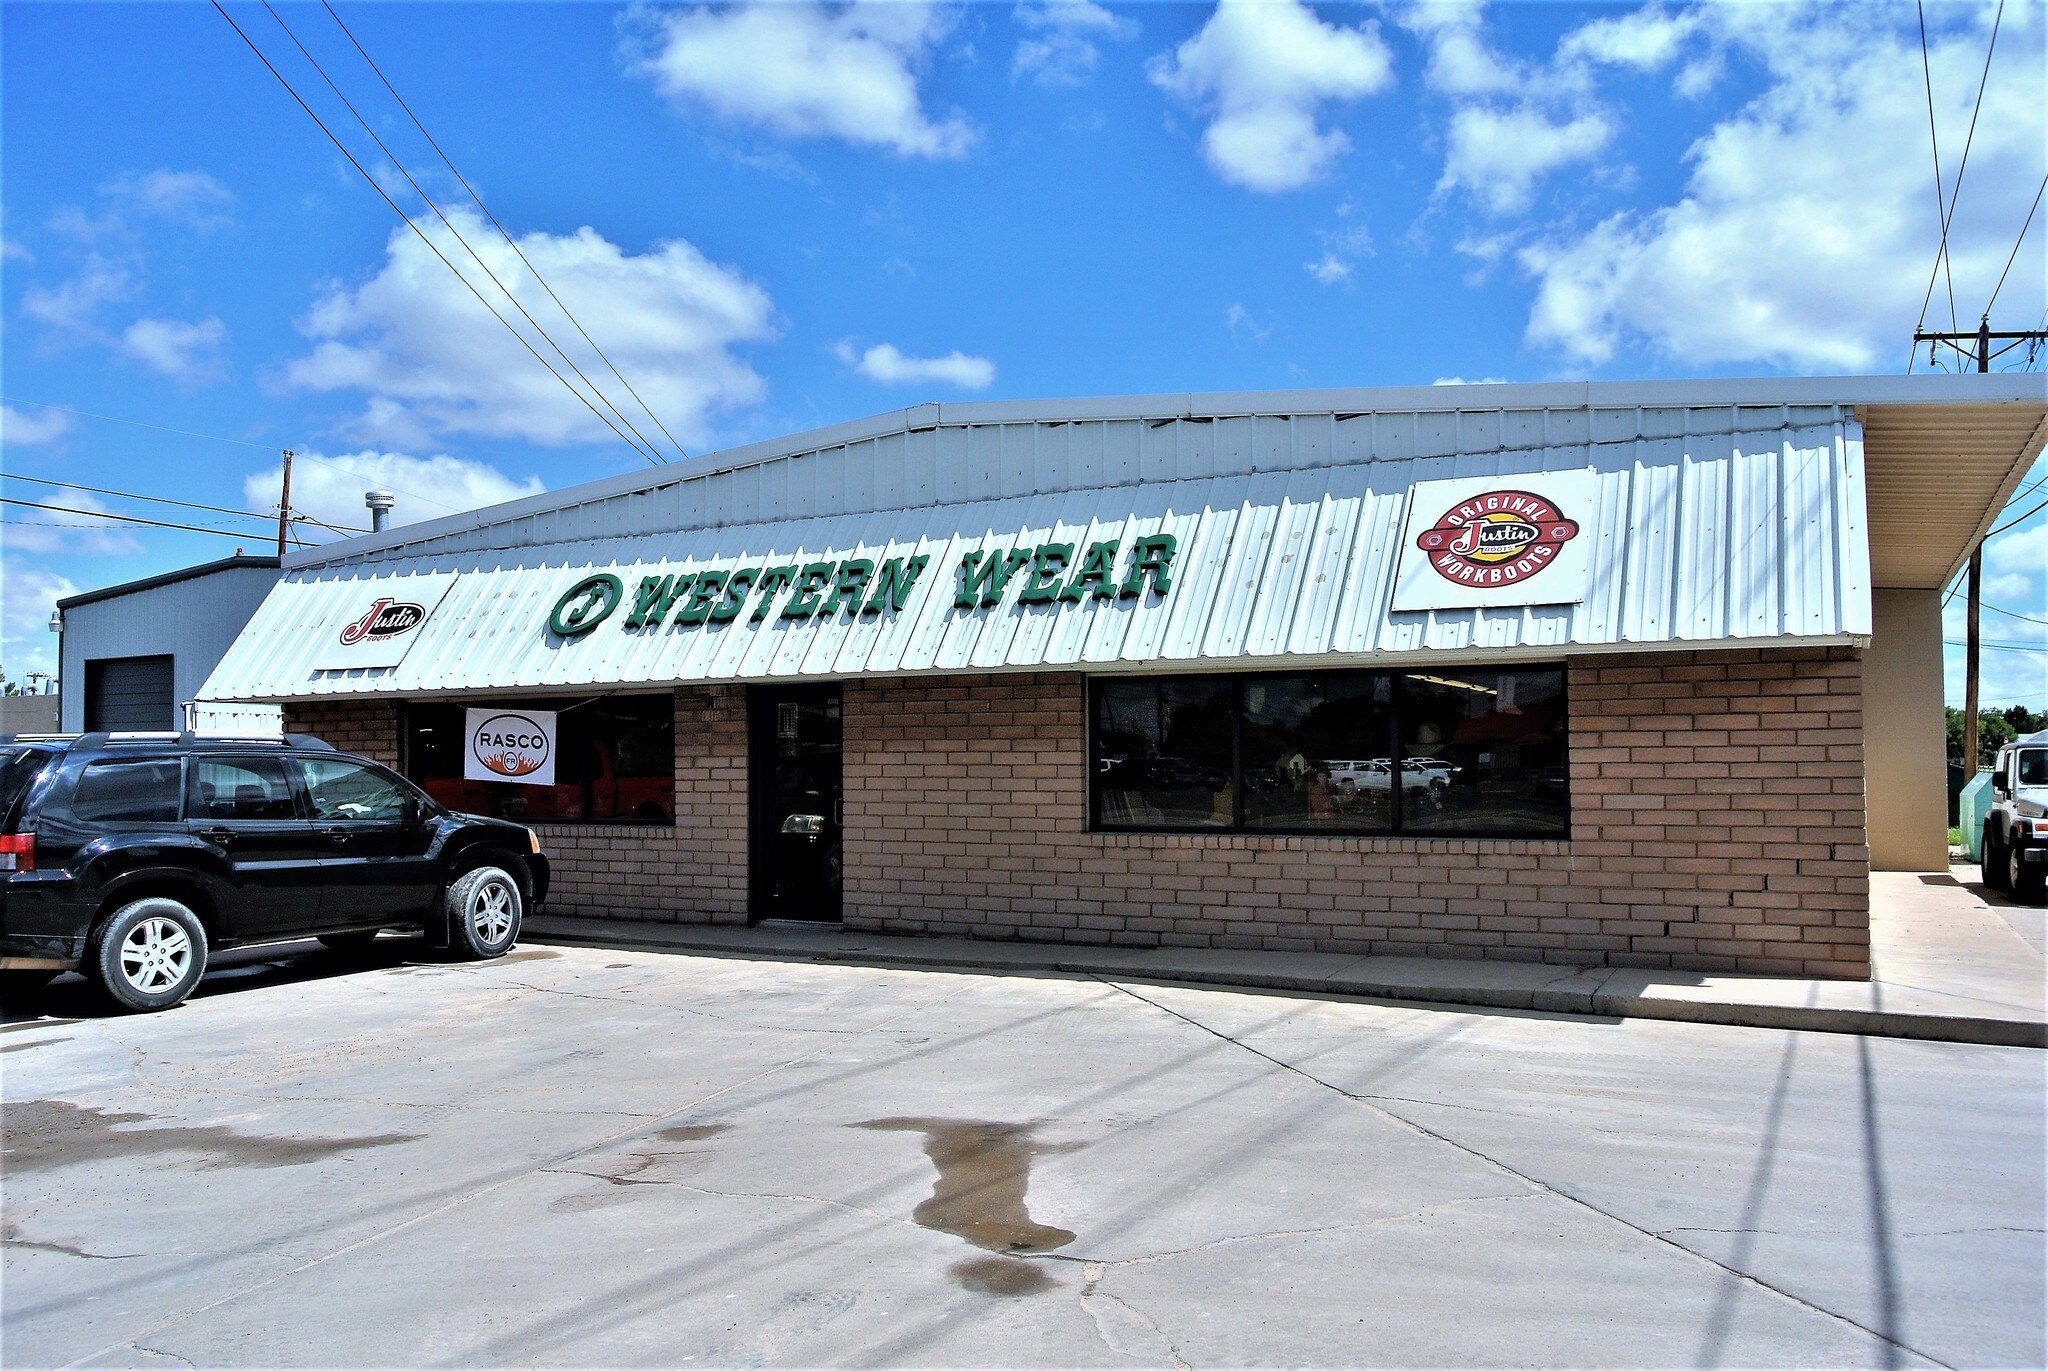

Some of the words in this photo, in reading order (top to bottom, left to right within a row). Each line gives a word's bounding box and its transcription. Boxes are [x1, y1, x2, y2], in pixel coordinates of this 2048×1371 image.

[1447, 495, 1548, 526] ORIGINAL
[1452, 522, 1530, 553] Justin
[1437, 545, 1552, 583] WORKBOOTS
[624, 554, 930, 629] WESTERN
[953, 533, 1177, 609] WEAR
[344, 600, 416, 642] Justin
[366, 633, 393, 642] BOOTS
[480, 732, 544, 750] RASCO
[506, 757, 516, 765] FR
